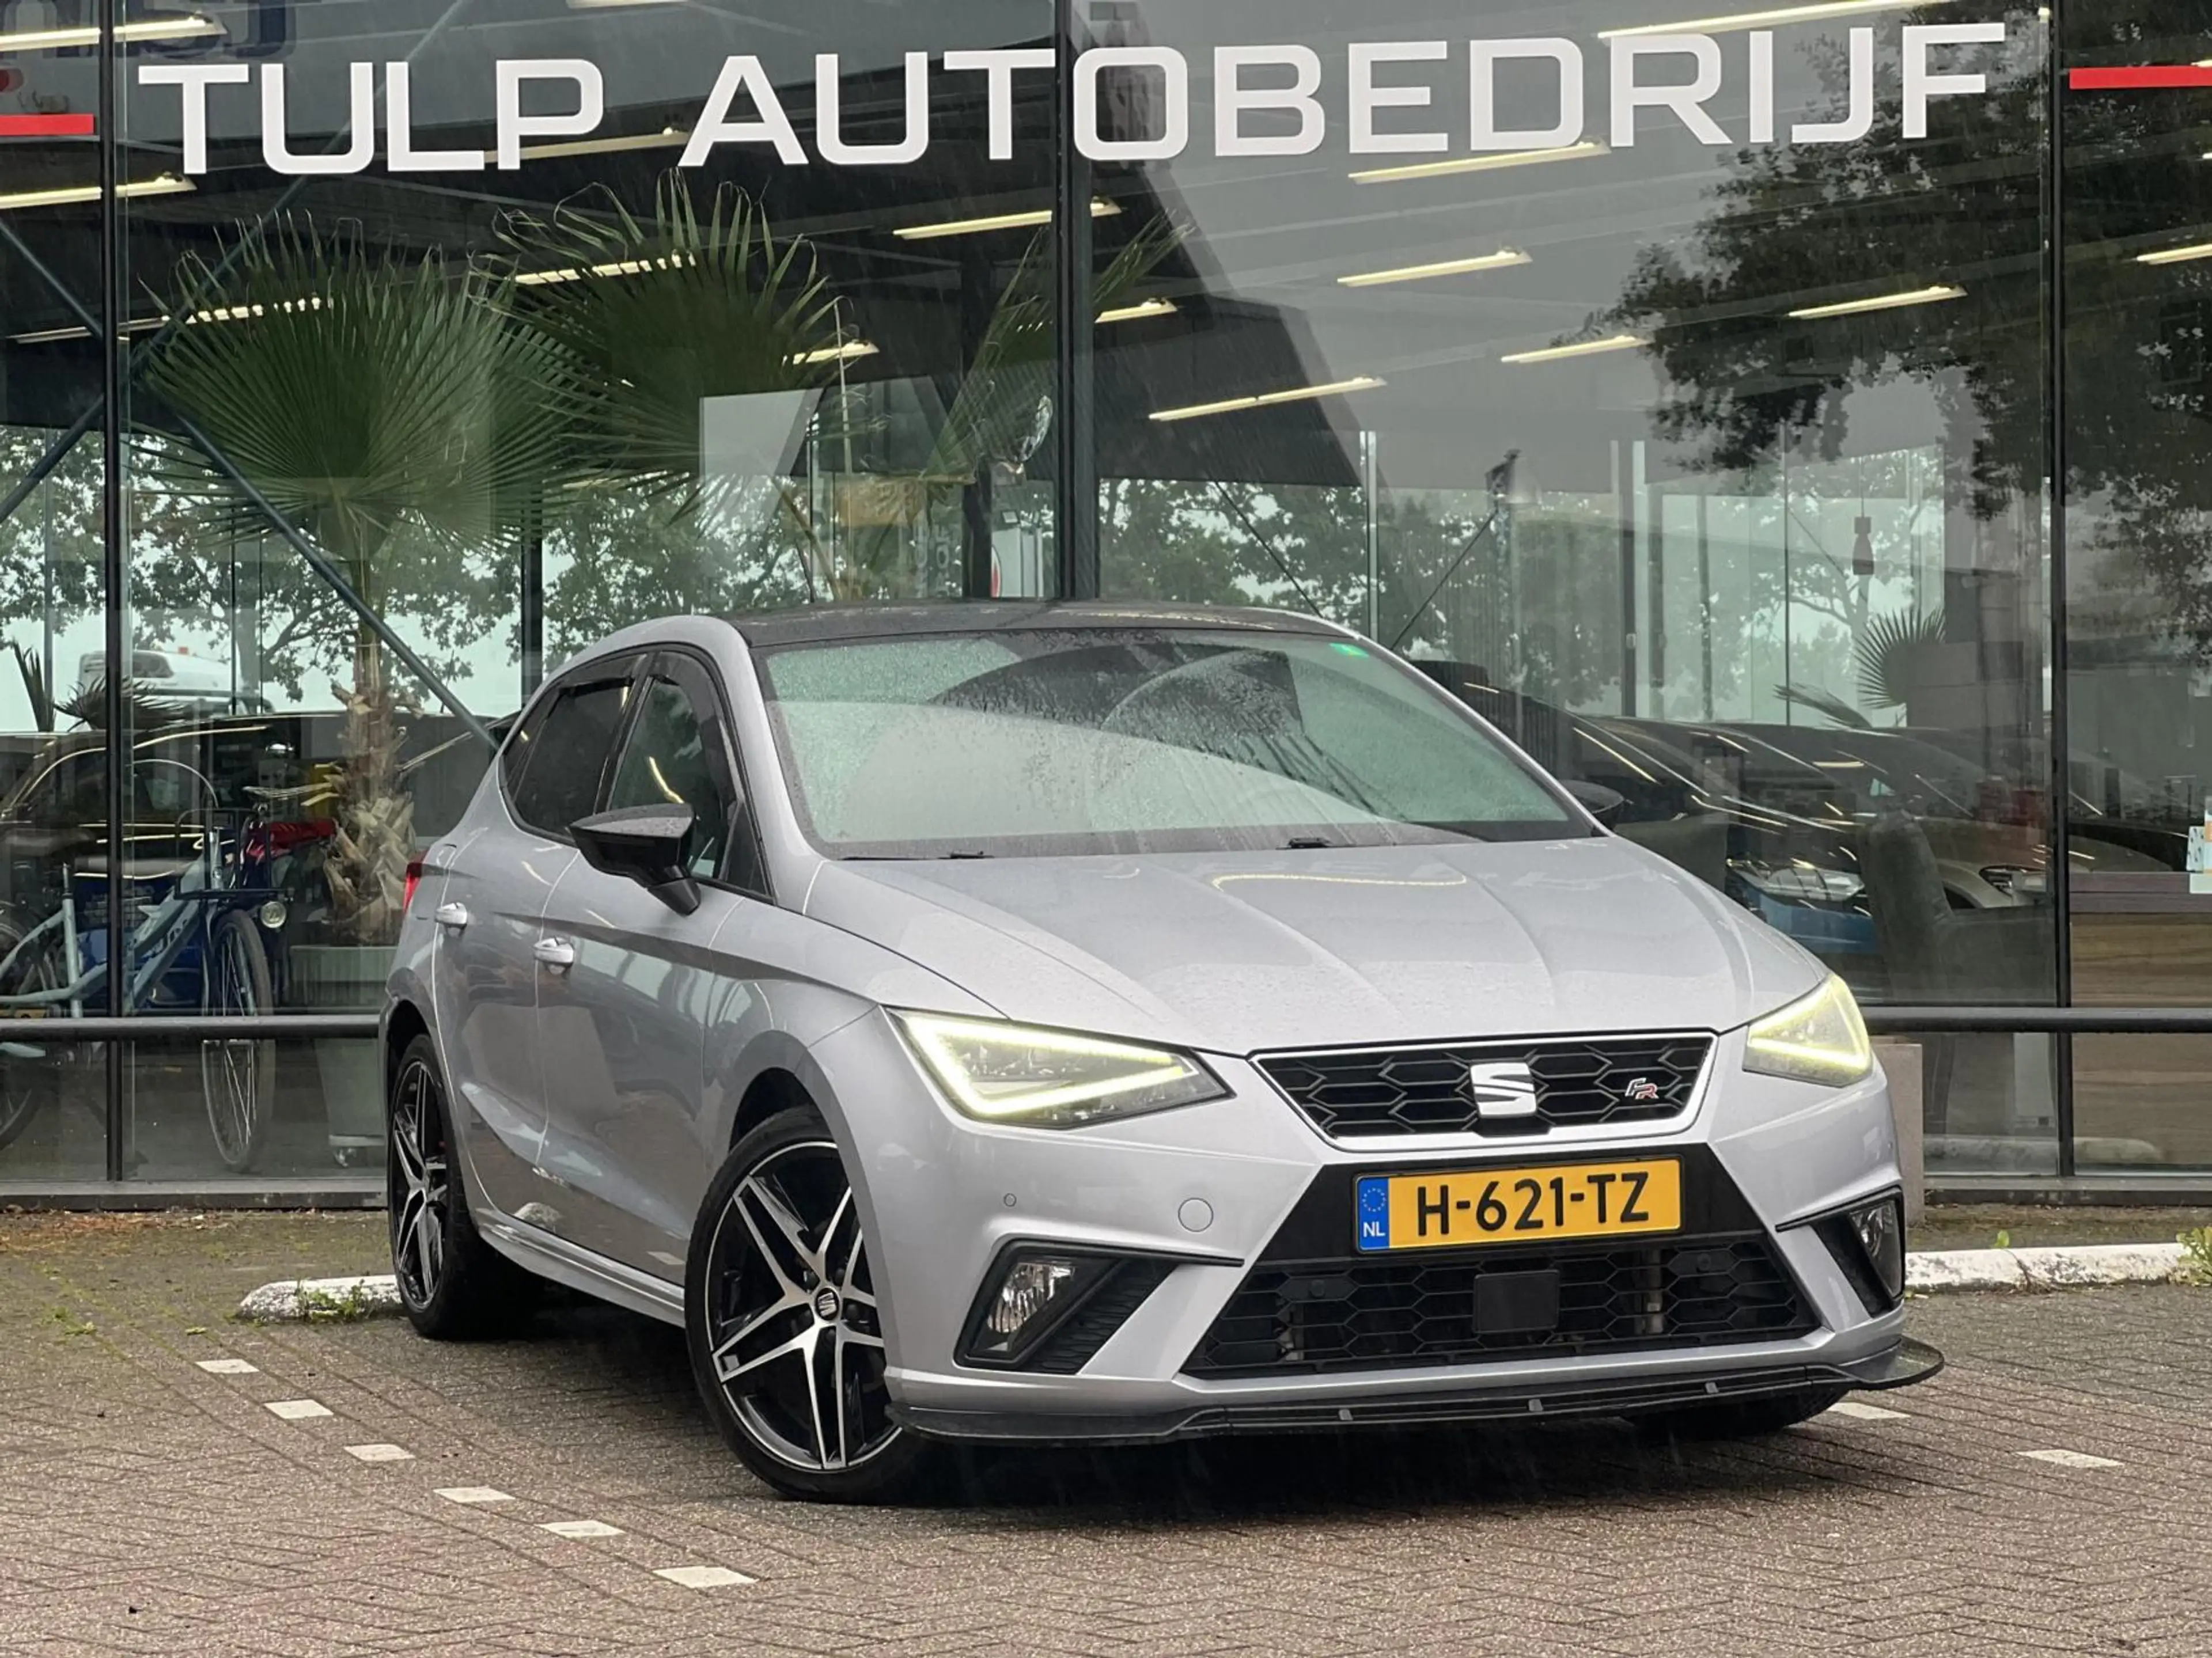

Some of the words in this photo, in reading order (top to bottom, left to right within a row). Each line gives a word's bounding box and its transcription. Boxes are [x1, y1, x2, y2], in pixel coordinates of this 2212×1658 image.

[138, 59, 604, 174] TULP
[678, 22, 2005, 167] AUTOBEDRIJF
[1363, 1221, 1385, 1237] NL
[1417, 1171, 1650, 1237] H-621-TZ
